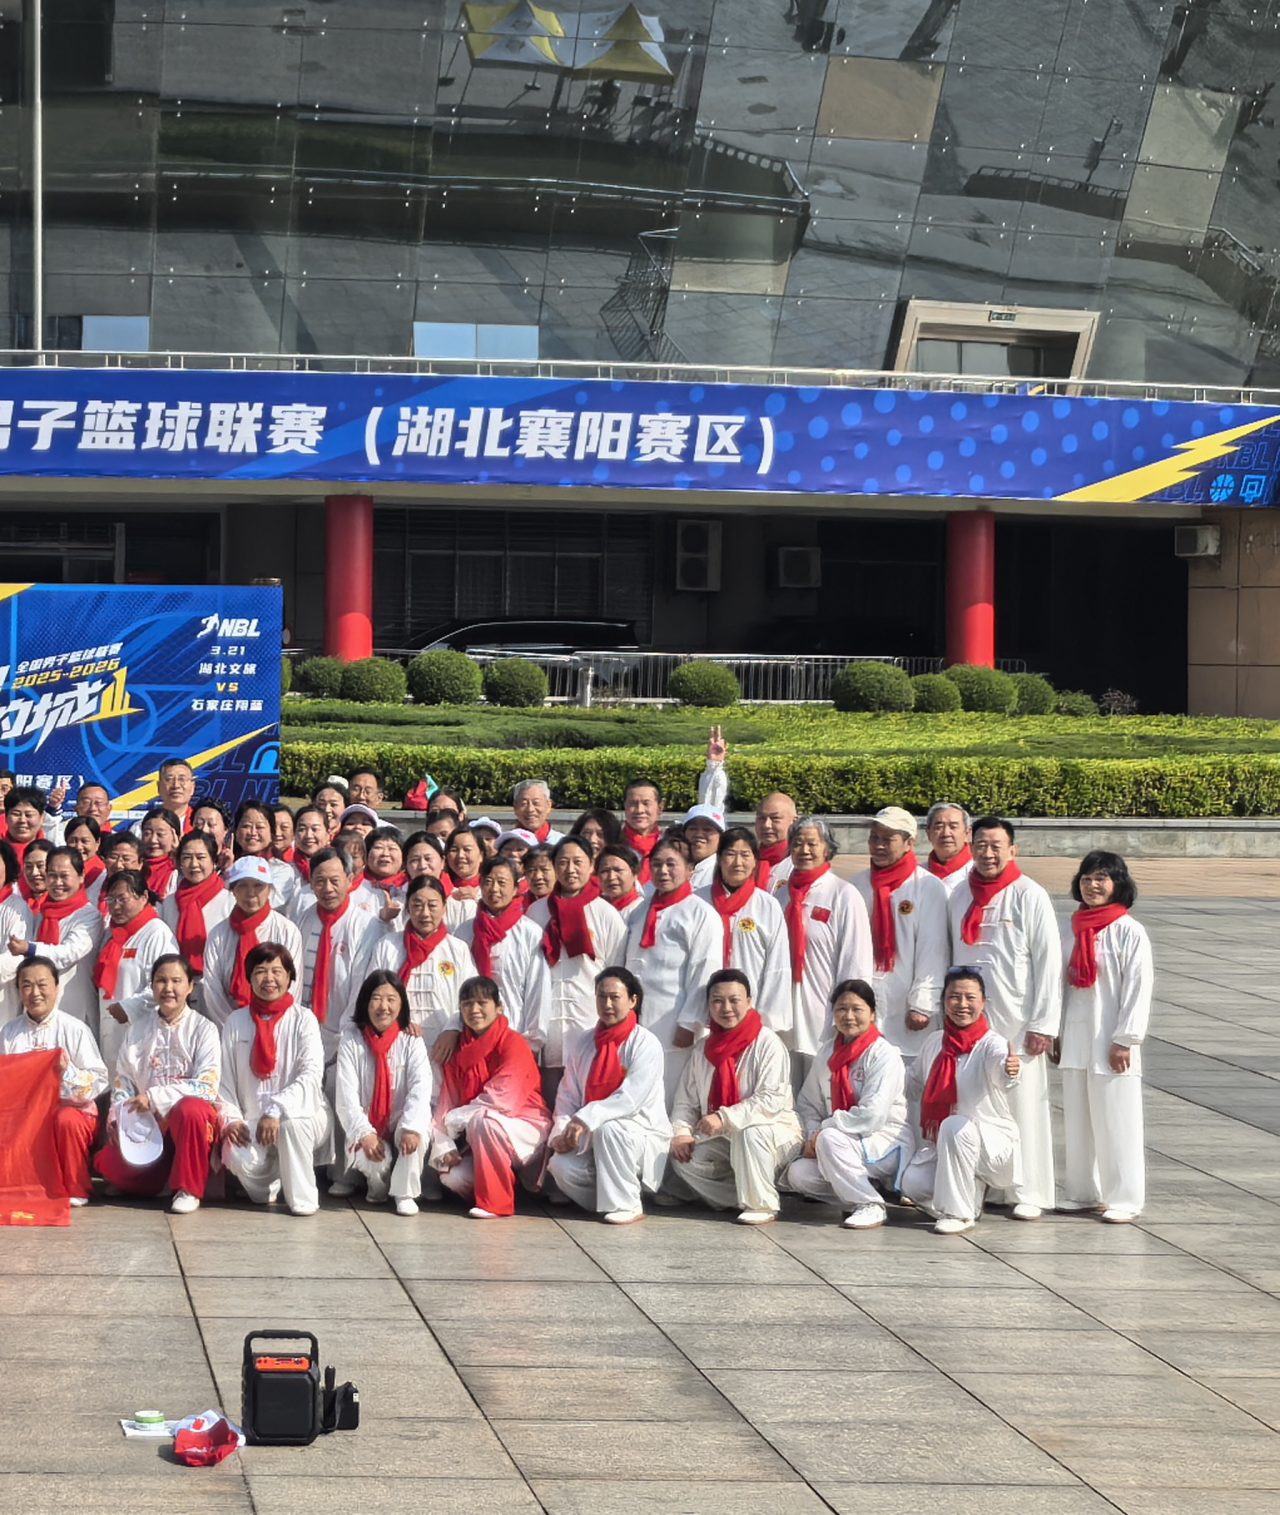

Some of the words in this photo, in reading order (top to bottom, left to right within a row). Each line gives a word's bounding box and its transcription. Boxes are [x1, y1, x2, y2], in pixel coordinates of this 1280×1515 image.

[217, 618, 261, 637] NBL
[16, 642, 123, 673] 全国男子篮球联赛
[210, 646, 245, 656] 3.21
[199, 662, 257, 675] 湖北文旅
[216, 682, 239, 692] VS
